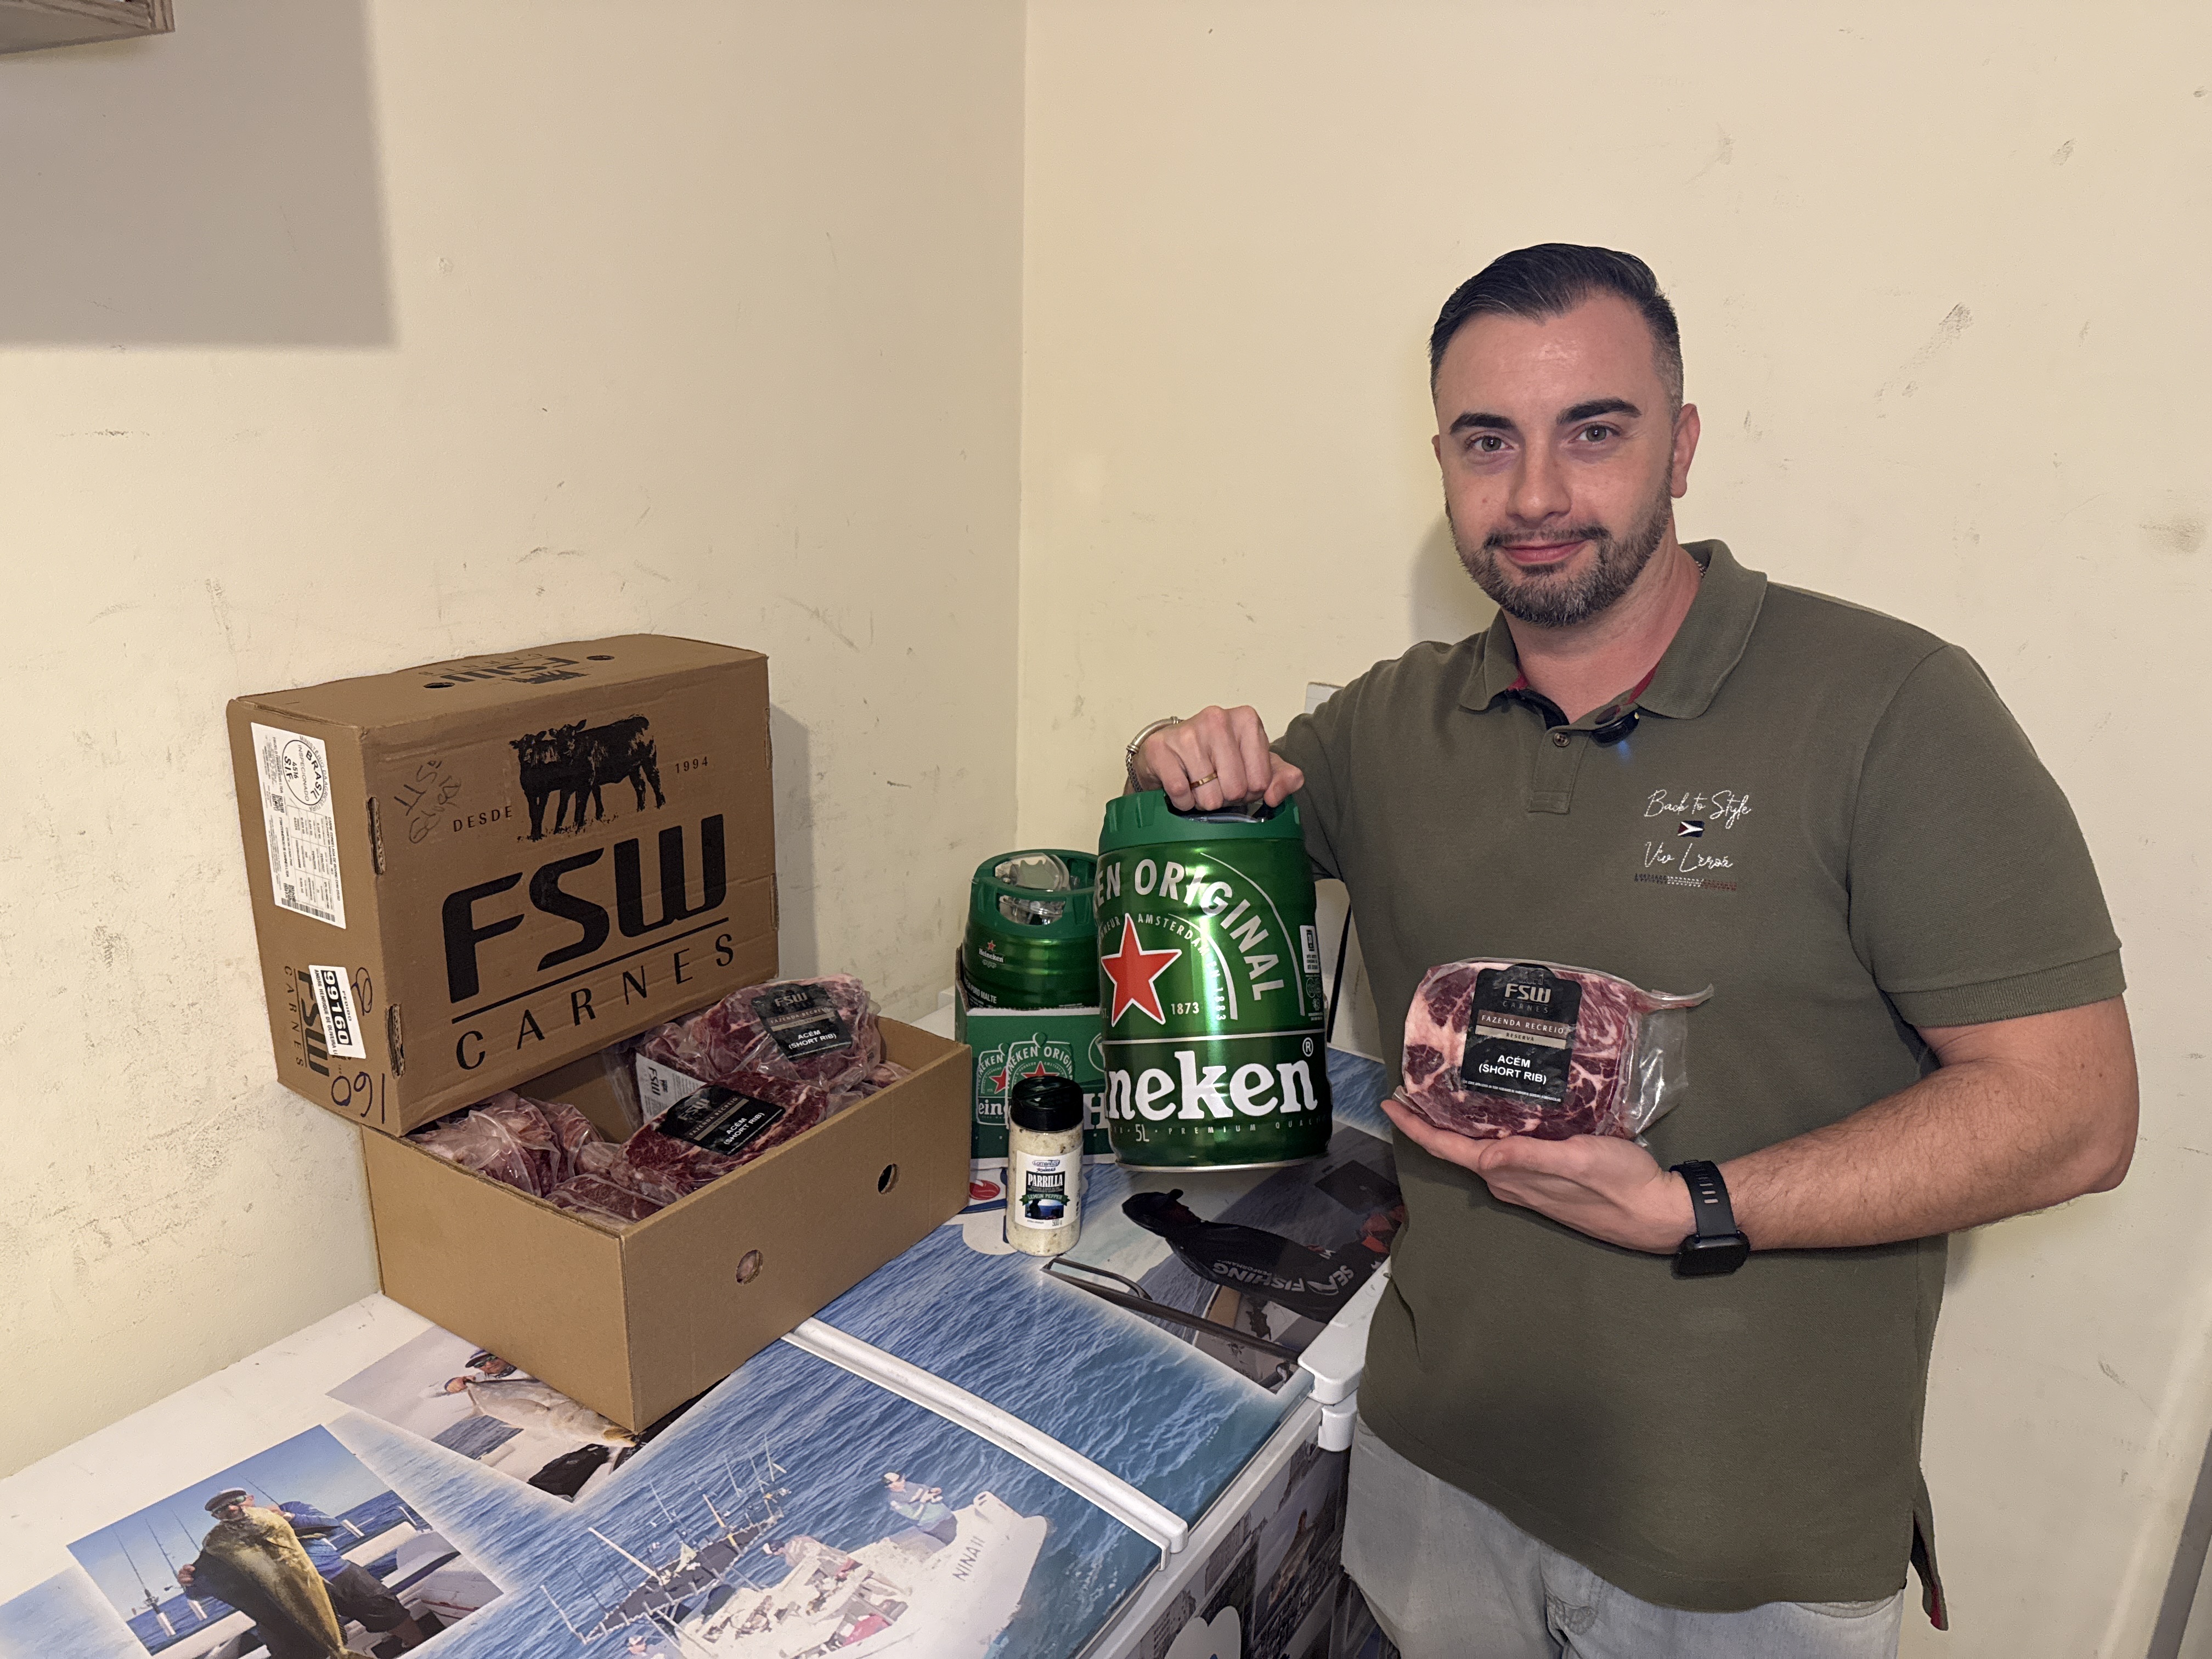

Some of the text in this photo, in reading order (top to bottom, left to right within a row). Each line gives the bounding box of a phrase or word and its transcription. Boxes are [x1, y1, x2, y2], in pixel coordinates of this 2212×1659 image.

[439, 657, 580, 683] FSW
[298, 744, 309, 802] INSPECIONADO
[306, 750, 322, 799] BRASIL
[674, 756, 709, 774] 1994
[453, 805, 513, 832] DESDE
[1644, 789, 1752, 829] Back to Style
[442, 814, 727, 1003] FSW
[1096, 859, 1284, 1001] EN ORIGINAL
[1138, 913, 1210, 956] AMSTERDAM
[979, 947, 1004, 963] Heineken
[1206, 961, 1220, 979] EN
[456, 933, 734, 1070] CARNES
[774, 992, 808, 1007] FSW
[980, 990, 997, 1004] MALTE
[1212, 986, 1226, 1020] 1883
[1504, 983, 1551, 1003] FSW
[284, 965, 304, 1066] CARNES
[314, 969, 323, 988] ANDRE
[319, 989, 329, 1015] HENRIQUE
[328, 1025, 337, 1048] OLIVEIRA
[323, 970, 349, 1045] 99160
[1171, 1002, 1199, 1015] 1873
[1503, 1000, 1549, 1013] CARNES
[770, 1014, 800, 1024] FAZENDA
[1481, 1015, 1564, 1034] FAZENDA RECREIO
[788, 1033, 837, 1050] (SHORT RIB)
[798, 1029, 821, 1040] ACÉM
[1506, 1032, 1534, 1042] RESERVA
[1497, 1055, 1531, 1068] ACÉM
[648, 1066, 661, 1096] FSW
[1479, 1063, 1547, 1085] (SHORT RIB)
[678, 1098, 710, 1121] FSW
[689, 1116, 715, 1136] FAZENDA
[715, 1097, 738, 1116] RECREIO
[723, 1113, 765, 1145] (SHORT RIB)
[726, 1118, 747, 1135] ACÉM
[1135, 1124, 1150, 1142] 5L
[1169, 1125, 1256, 1135] PREMIUM
[1028, 1173, 1063, 1188] PARRILLA
[1212, 1262, 1305, 1293] FISHING
[952, 1547, 981, 1582] NINA
